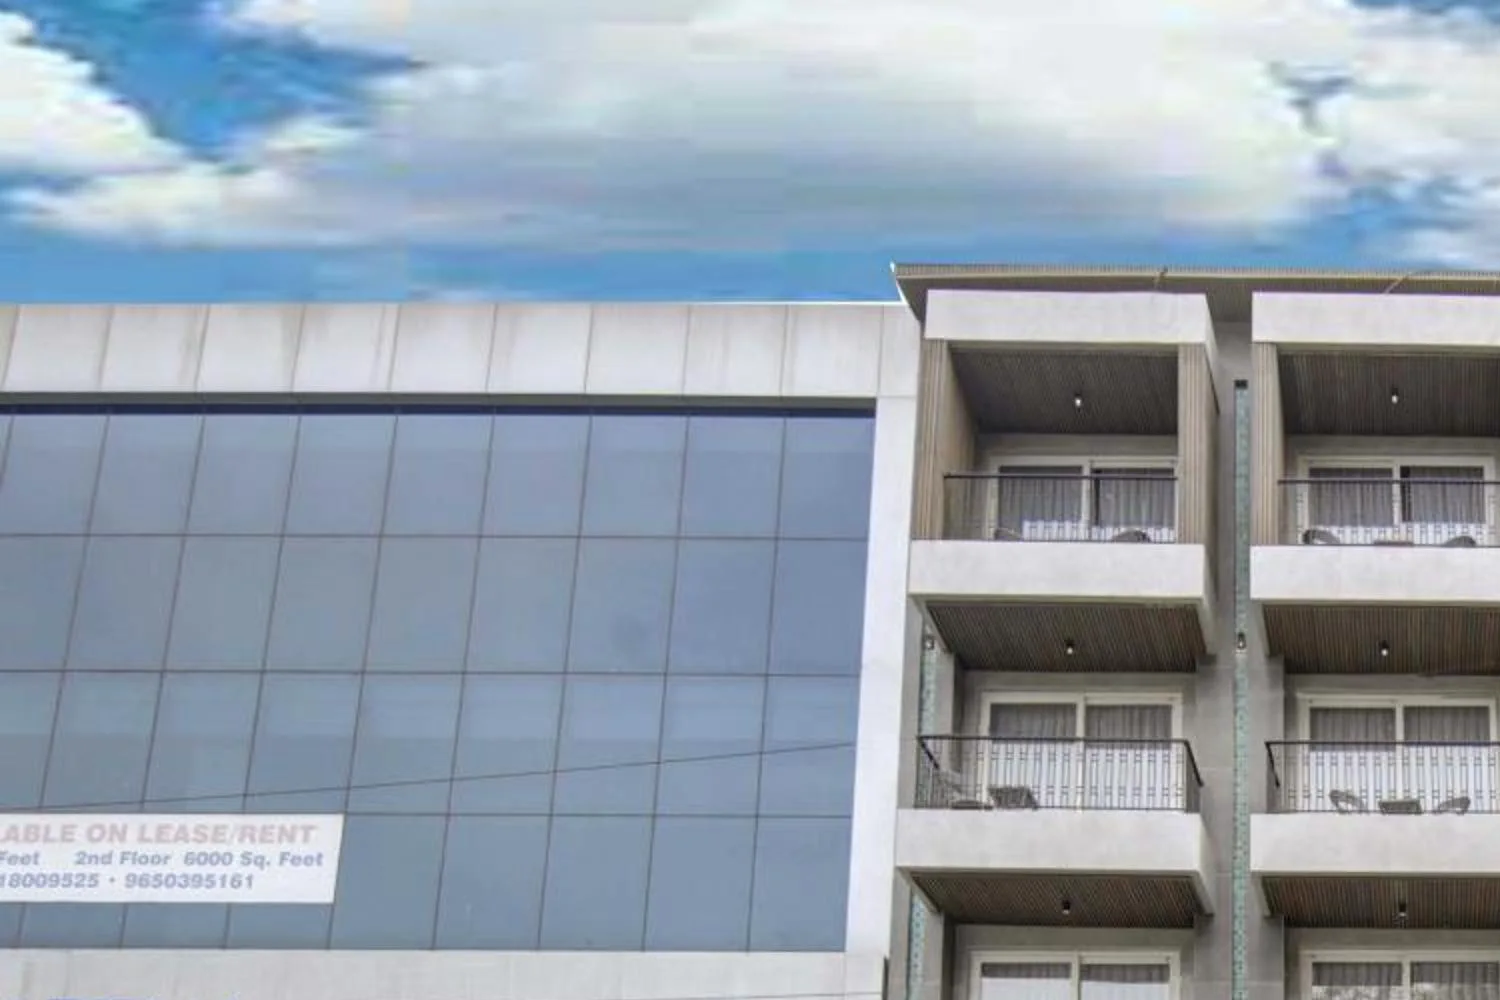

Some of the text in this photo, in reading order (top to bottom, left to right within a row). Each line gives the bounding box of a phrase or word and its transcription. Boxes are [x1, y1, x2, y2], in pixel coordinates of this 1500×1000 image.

[86, 823, 128, 844] ON
[137, 823, 318, 845] LEASE/RENT
[74, 850, 114, 866] 2nd
[119, 850, 173, 866] Floor
[183, 851, 234, 867] 6000
[239, 851, 271, 870] Sq.
[279, 851, 325, 867] Feet
